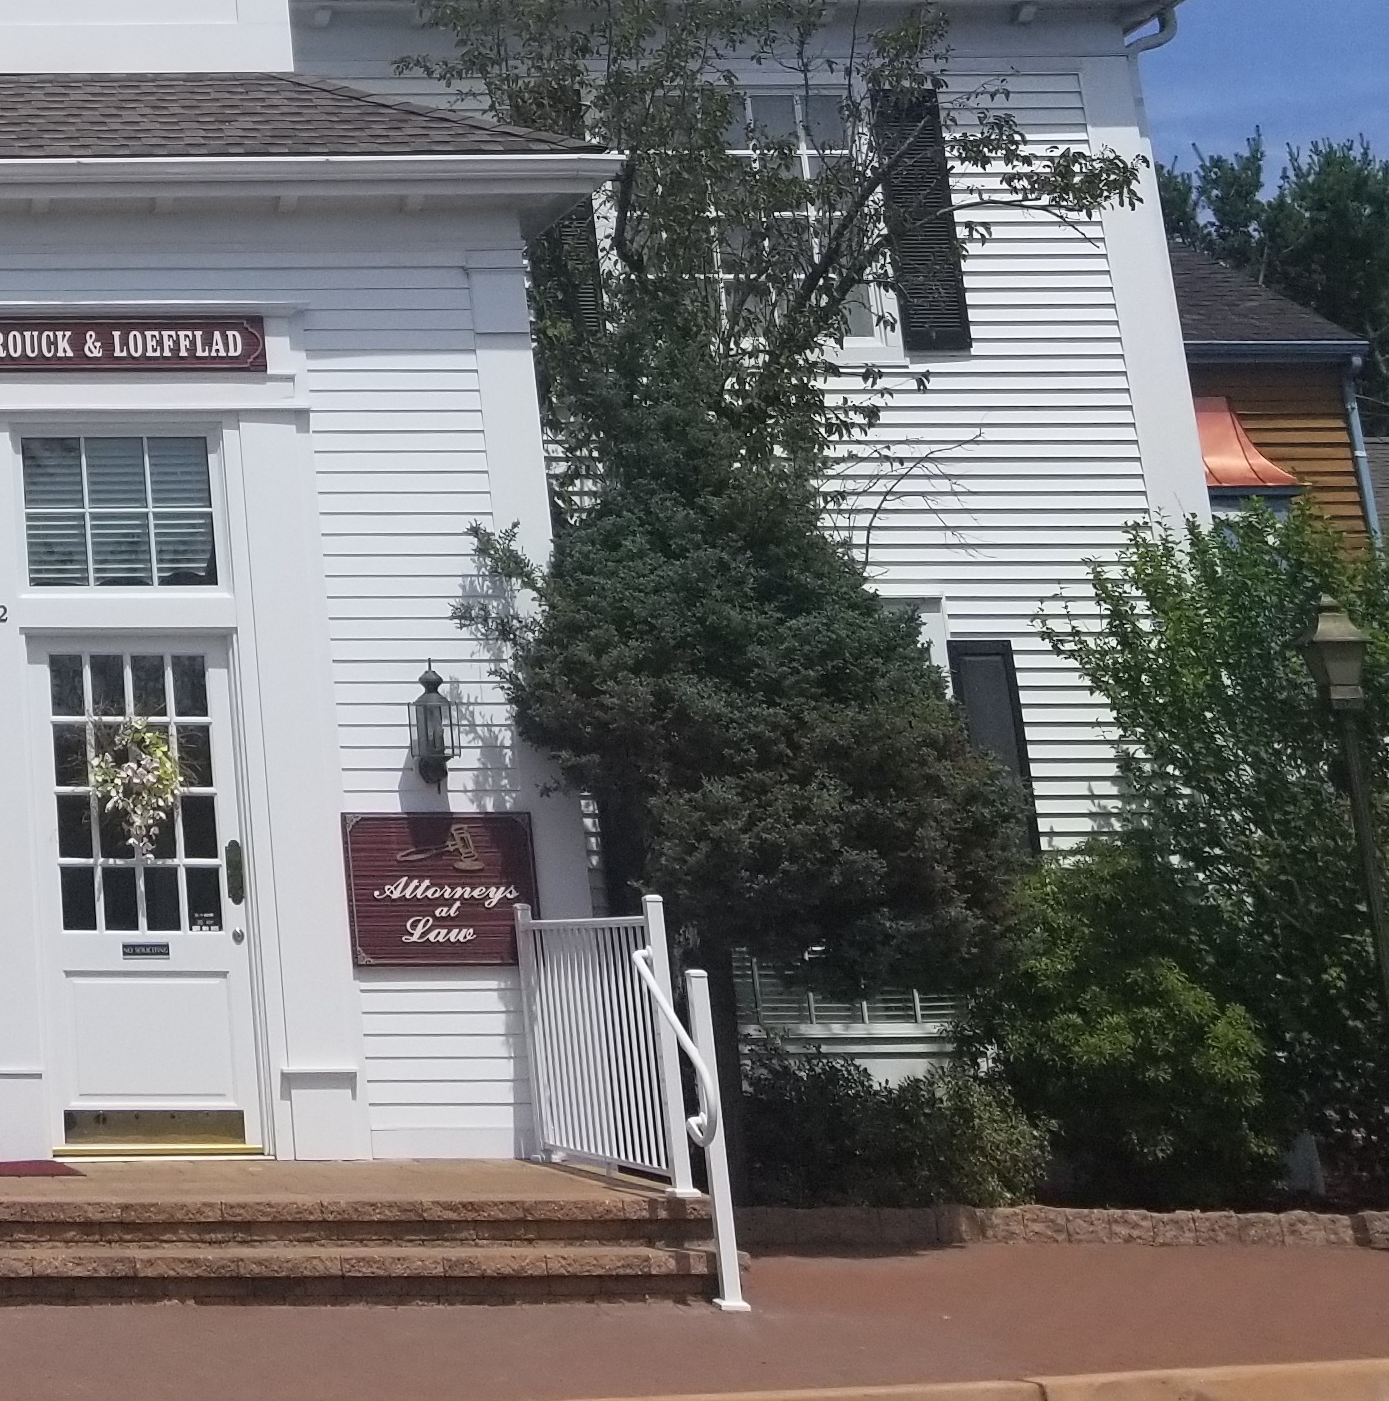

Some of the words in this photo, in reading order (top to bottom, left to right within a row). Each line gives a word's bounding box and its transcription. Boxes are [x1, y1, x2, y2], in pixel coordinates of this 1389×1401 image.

[84, 330, 103, 357] &
[112, 330, 242, 357] LOEFFLAD
[374, 876, 519, 908] Attorneys
[434, 901, 462, 917] at
[402, 917, 477, 943] Law
